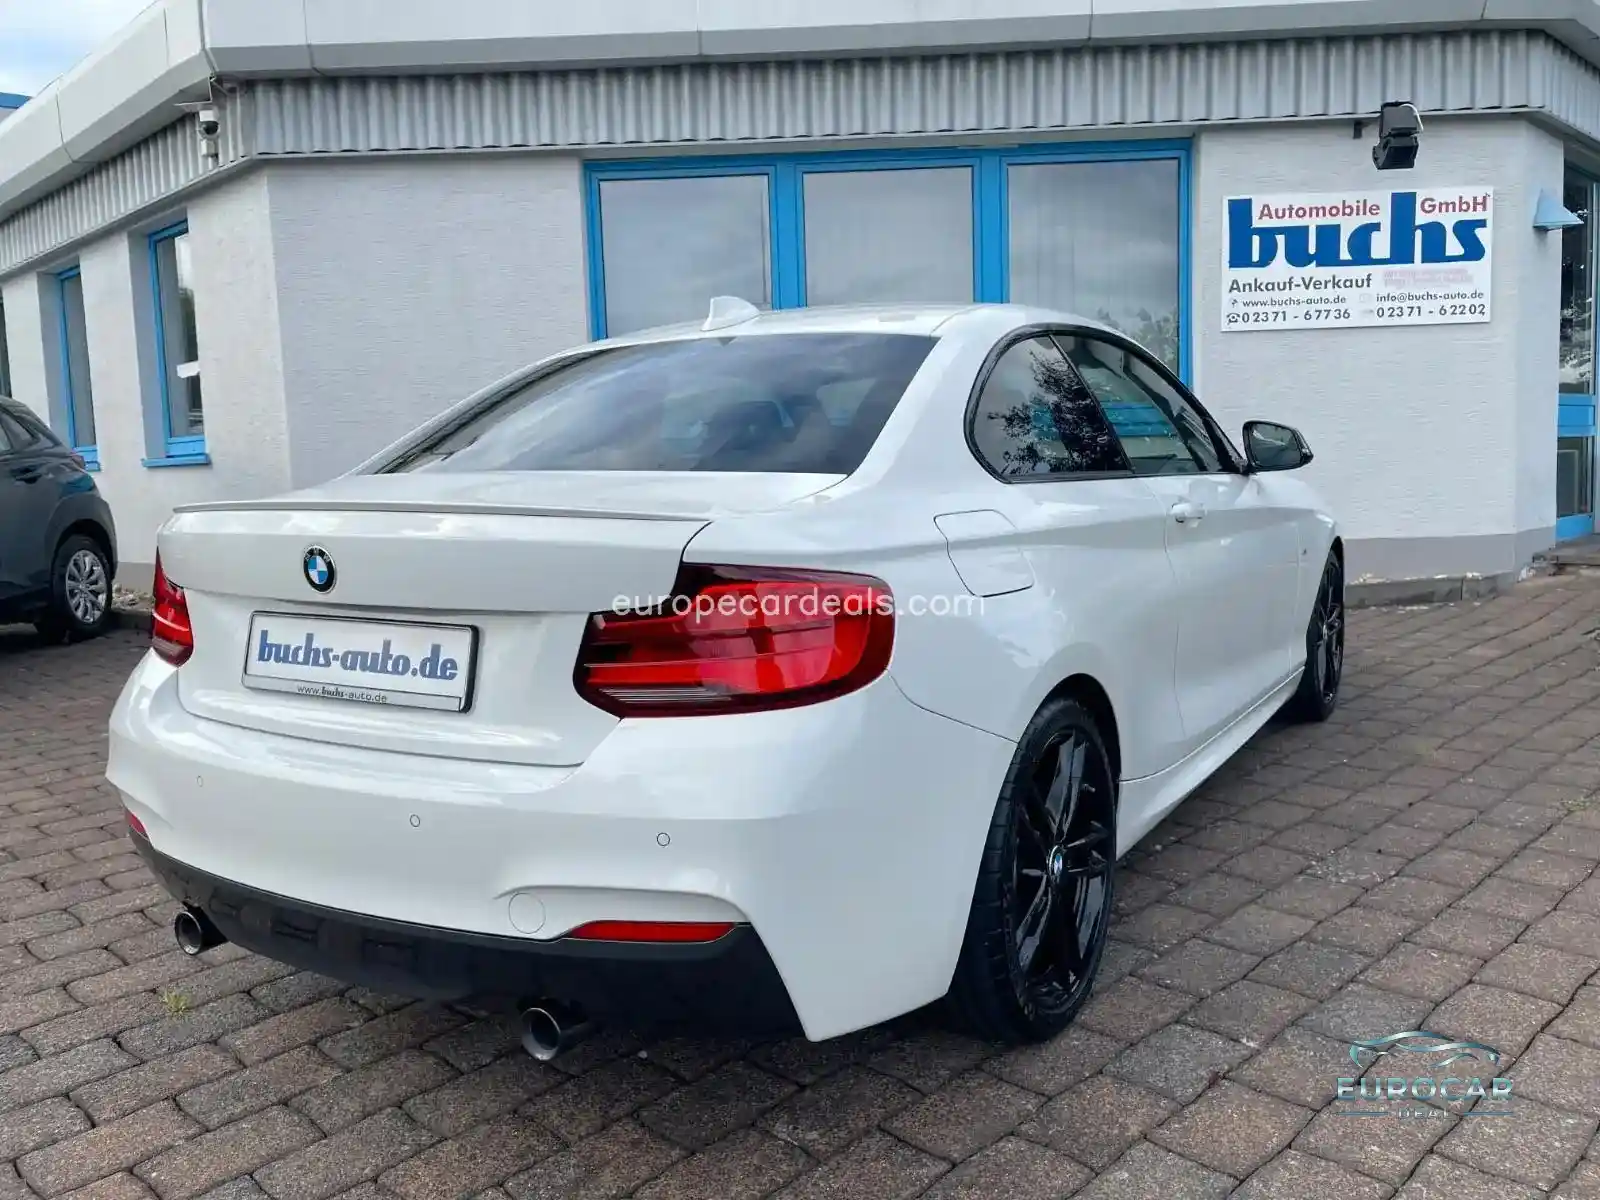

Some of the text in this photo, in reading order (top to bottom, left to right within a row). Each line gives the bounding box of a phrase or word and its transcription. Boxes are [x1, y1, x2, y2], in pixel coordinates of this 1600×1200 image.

[1258, 195, 1487, 220] Automobile GmbH
[1228, 191, 1487, 269] buchs
[1228, 273, 1373, 293] Ankauf-Verkauf
[1242, 295, 1347, 307] www.buchs-auto.de
[1376, 290, 1484, 303] info@buchs-auto.de
[257, 629, 458, 681] buchs-auto.de
[297, 685, 387, 704] www.buchs-auto.de
